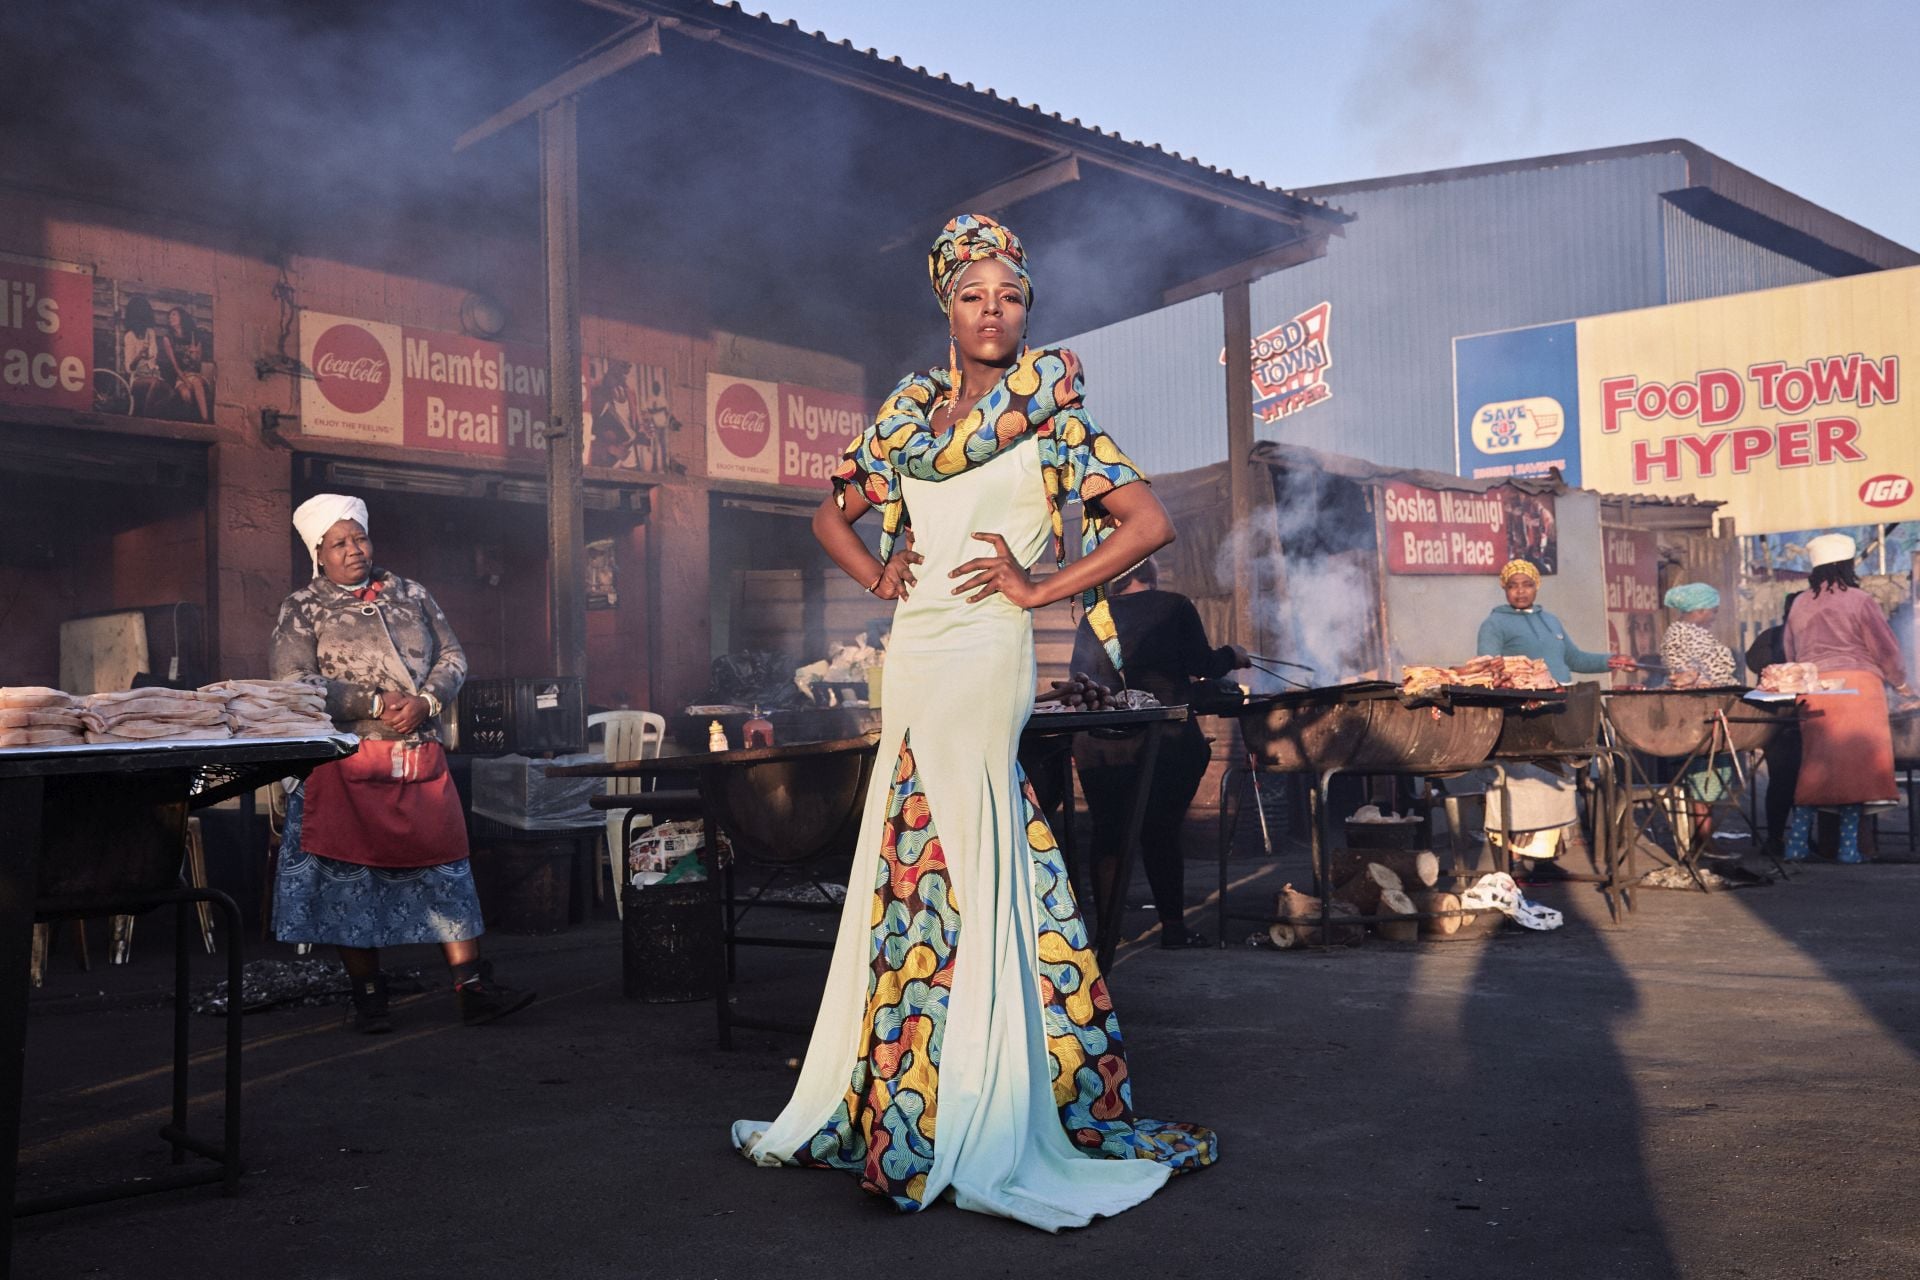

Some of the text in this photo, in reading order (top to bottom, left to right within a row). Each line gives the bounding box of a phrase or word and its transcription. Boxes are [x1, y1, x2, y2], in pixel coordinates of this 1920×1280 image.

[1251, 320, 1307, 360] OOD
[3, 348, 86, 392] ace
[317, 352, 385, 384] Coca-Cola
[1255, 342, 1326, 387] TOWN
[1261, 384, 1330, 422] HYPER
[1600, 353, 1899, 433] FOOD TOWN
[314, 418, 339, 427] ENJOY
[341, 421, 356, 430] THE
[427, 396, 499, 445] Braai
[719, 407, 767, 433] Coca-Cola
[1482, 405, 1527, 423] SAVE
[1487, 433, 1522, 449] LOT
[1631, 417, 1866, 484] HYPER
[1863, 479, 1909, 503] IGA
[1385, 489, 1504, 533] Sosha Mazinigi
[1403, 531, 1494, 565] Braai Place
[1624, 577, 1658, 610] Place
